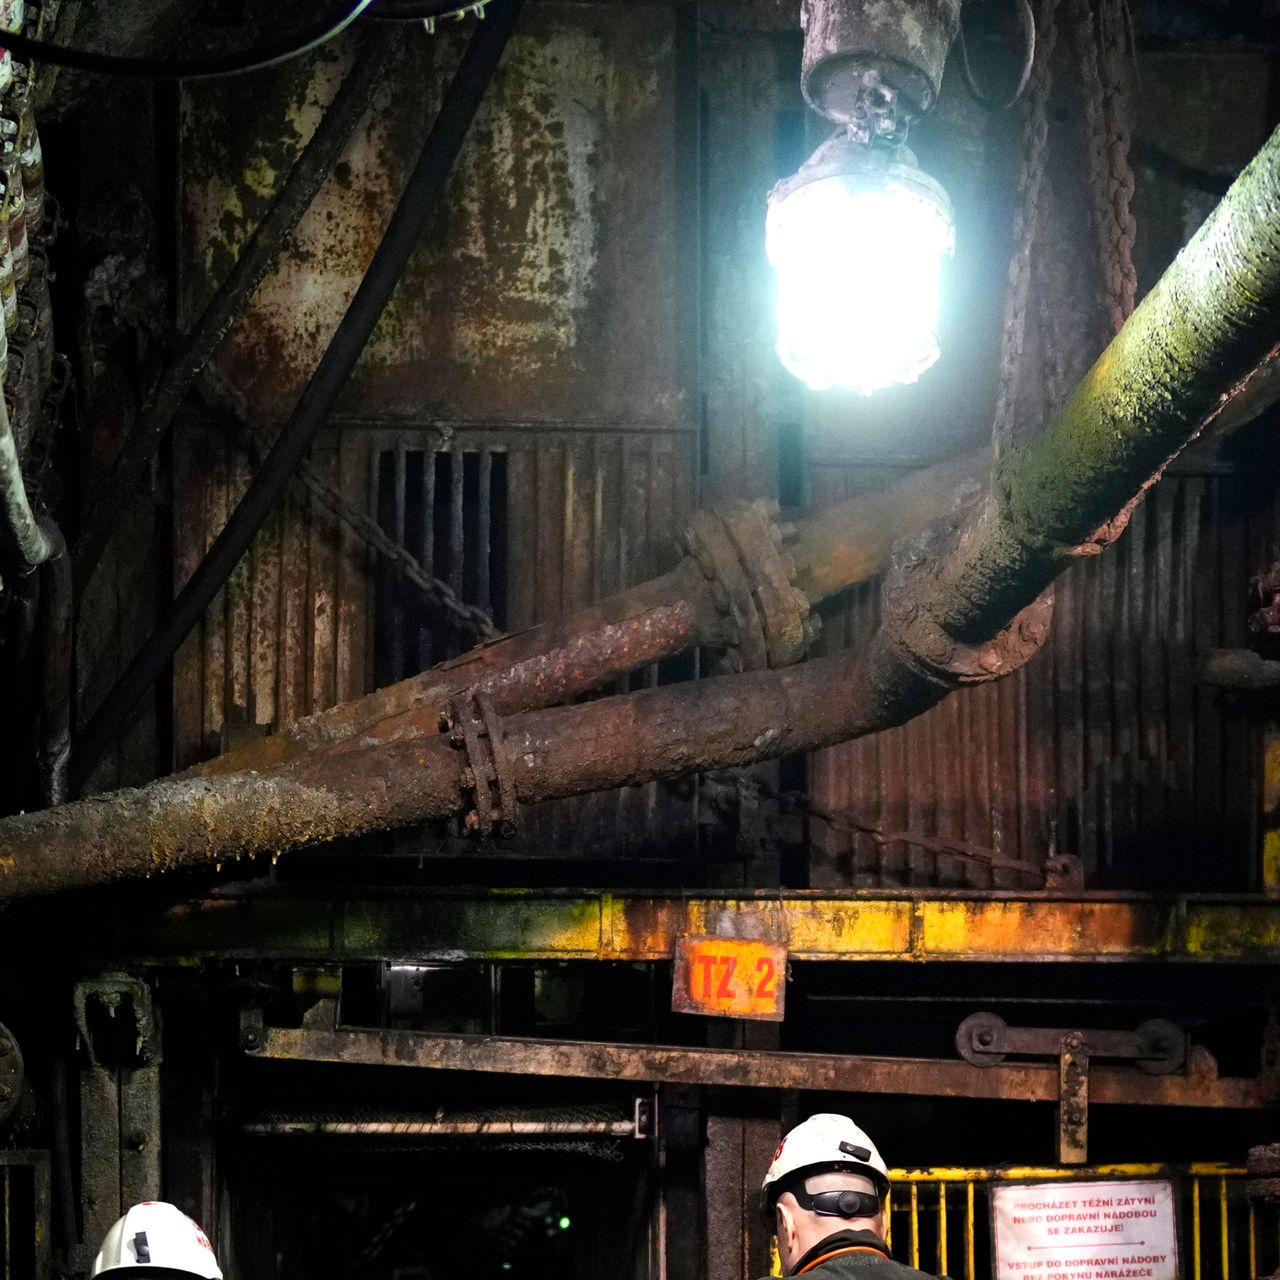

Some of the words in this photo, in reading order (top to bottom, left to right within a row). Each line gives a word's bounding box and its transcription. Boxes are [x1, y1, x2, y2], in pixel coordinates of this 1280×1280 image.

[697, 955, 737, 998] TZ
[755, 957, 775, 998] 2
[1014, 1201, 1078, 1210] PROCHÁZET
[1082, 1199, 1112, 1208] TĚŽNÍ
[1117, 1196, 1155, 1206] ZÁTYNÍ
[1013, 1215, 1042, 1224] NEBO
[1046, 1213, 1099, 1222] DOPRAVNÍ
[1104, 1210, 1156, 1219] NÁDOBOU
[1064, 1225, 1124, 1234] ZAKAZUJE!
[1065, 1258, 1118, 1267] DOPRAVNÍ
[1122, 1255, 1167, 1264] NÁDOBY
[1047, 1273, 1092, 1280] POKYNU
[1096, 1269, 1152, 1278] NARÁŽEČE
